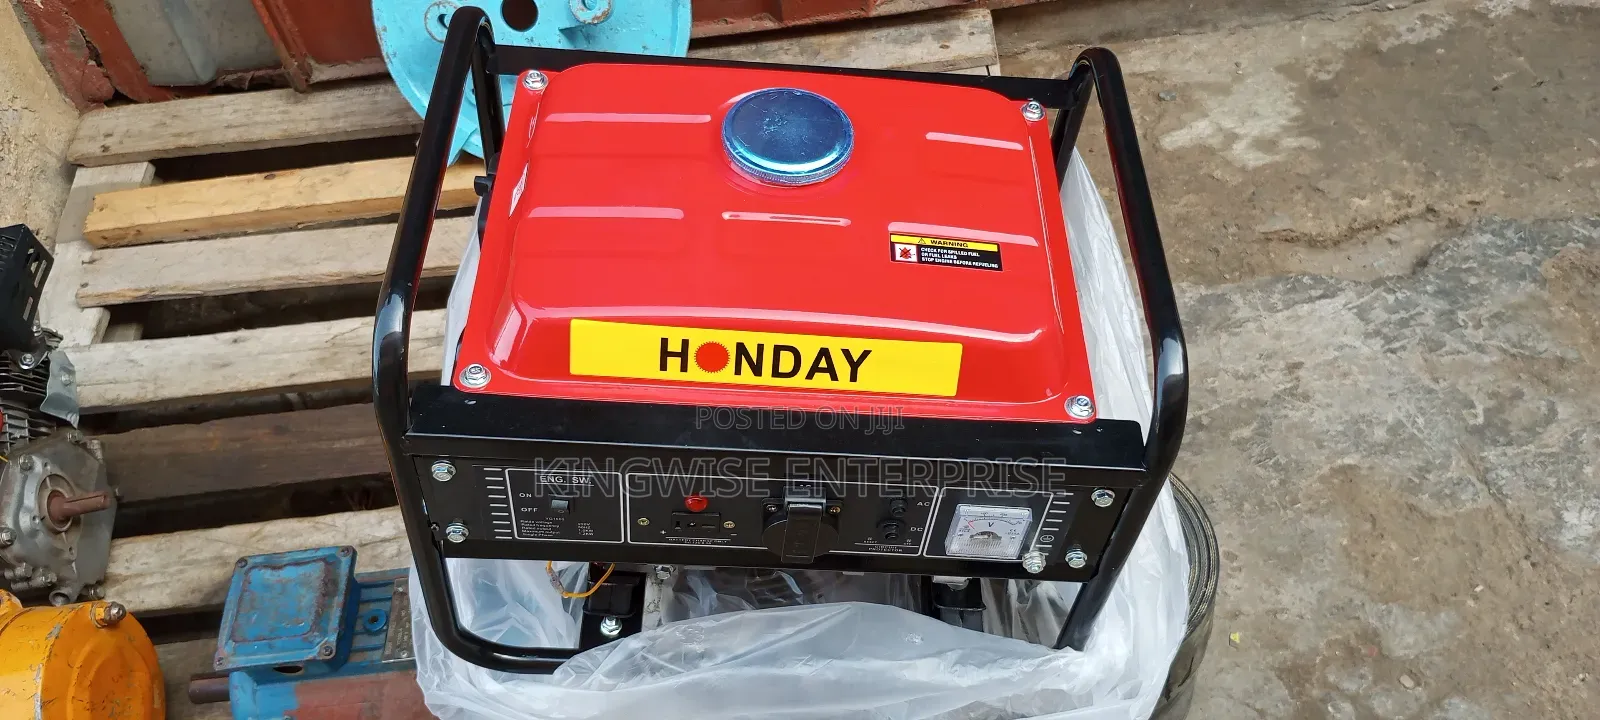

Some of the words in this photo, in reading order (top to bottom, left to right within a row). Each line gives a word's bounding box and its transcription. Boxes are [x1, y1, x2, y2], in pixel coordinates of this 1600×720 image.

[930, 239, 969, 248] WARNING
[658, 337, 872, 383] HONDAY
[540, 475, 567, 484] ENG.
[572, 476, 592, 484] SW.
